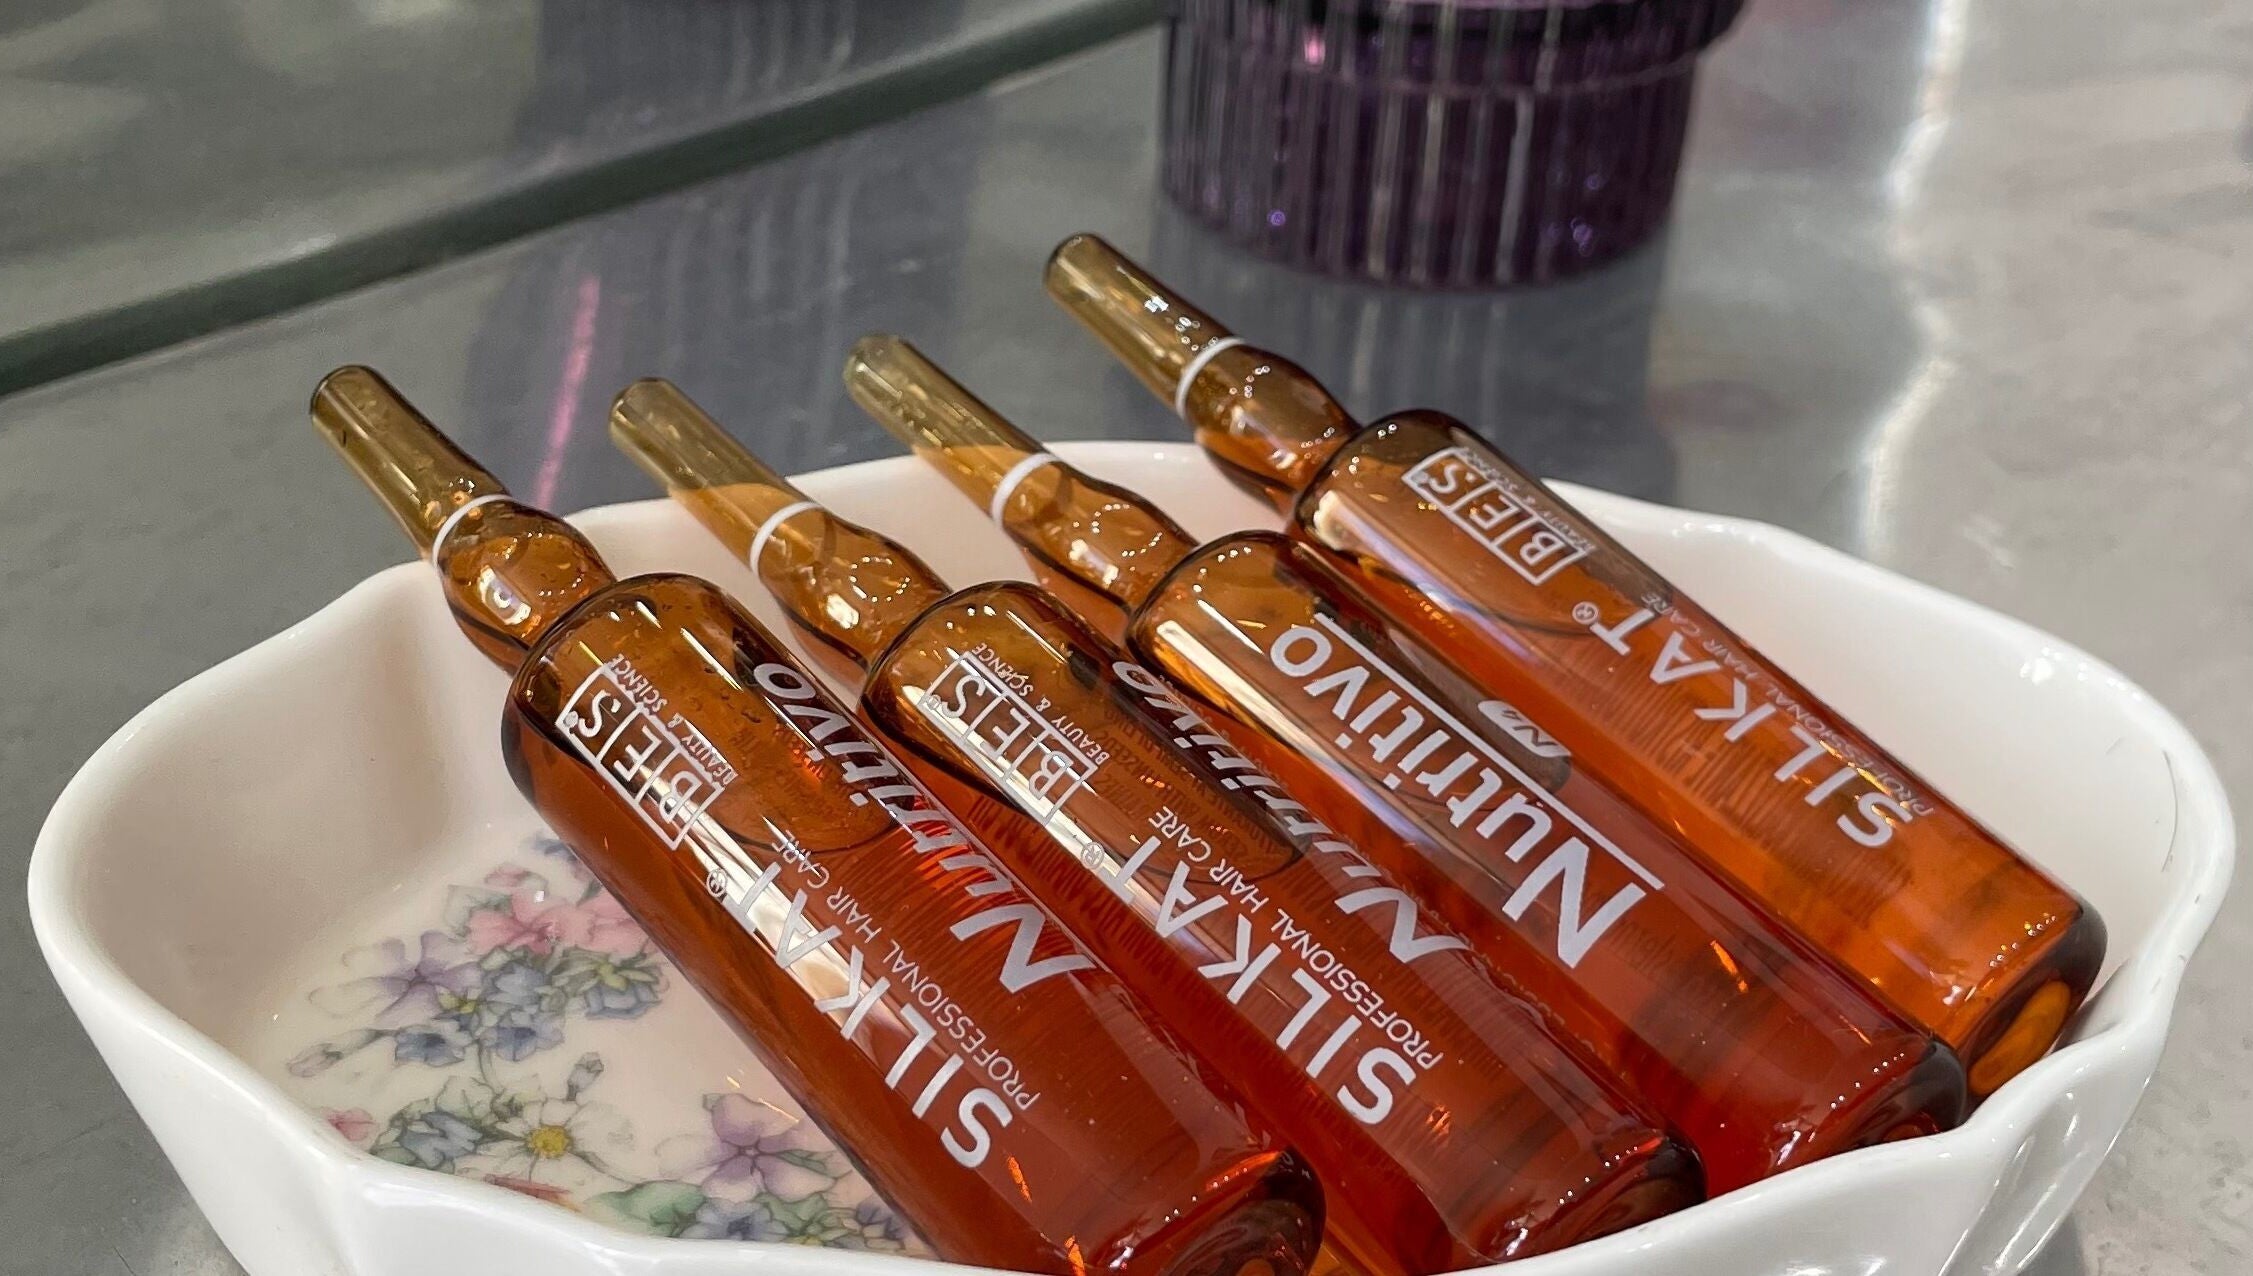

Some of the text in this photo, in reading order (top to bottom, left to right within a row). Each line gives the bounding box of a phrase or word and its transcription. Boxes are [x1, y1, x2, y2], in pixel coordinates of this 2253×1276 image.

[611, 653, 668, 713] SCIENCE
[972, 642, 1034, 696] SCIENCE
[1702, 639, 1758, 680] HAIR
[1036, 697, 1051, 712] &
[680, 735, 738, 786] BEAUTY
[1051, 715, 1111, 765] BEAUTY
[1112, 661, 1471, 963] Nutritivo
[1270, 624, 1647, 969] Nutritivo
[754, 663, 1097, 994] Nutritivo
[772, 830, 830, 889] CARE
[826, 886, 882, 943] HAIR
[1148, 805, 1444, 1070] PROFESSIONAL HAIR CARE
[883, 940, 1041, 1110] PROFESSIONAL
